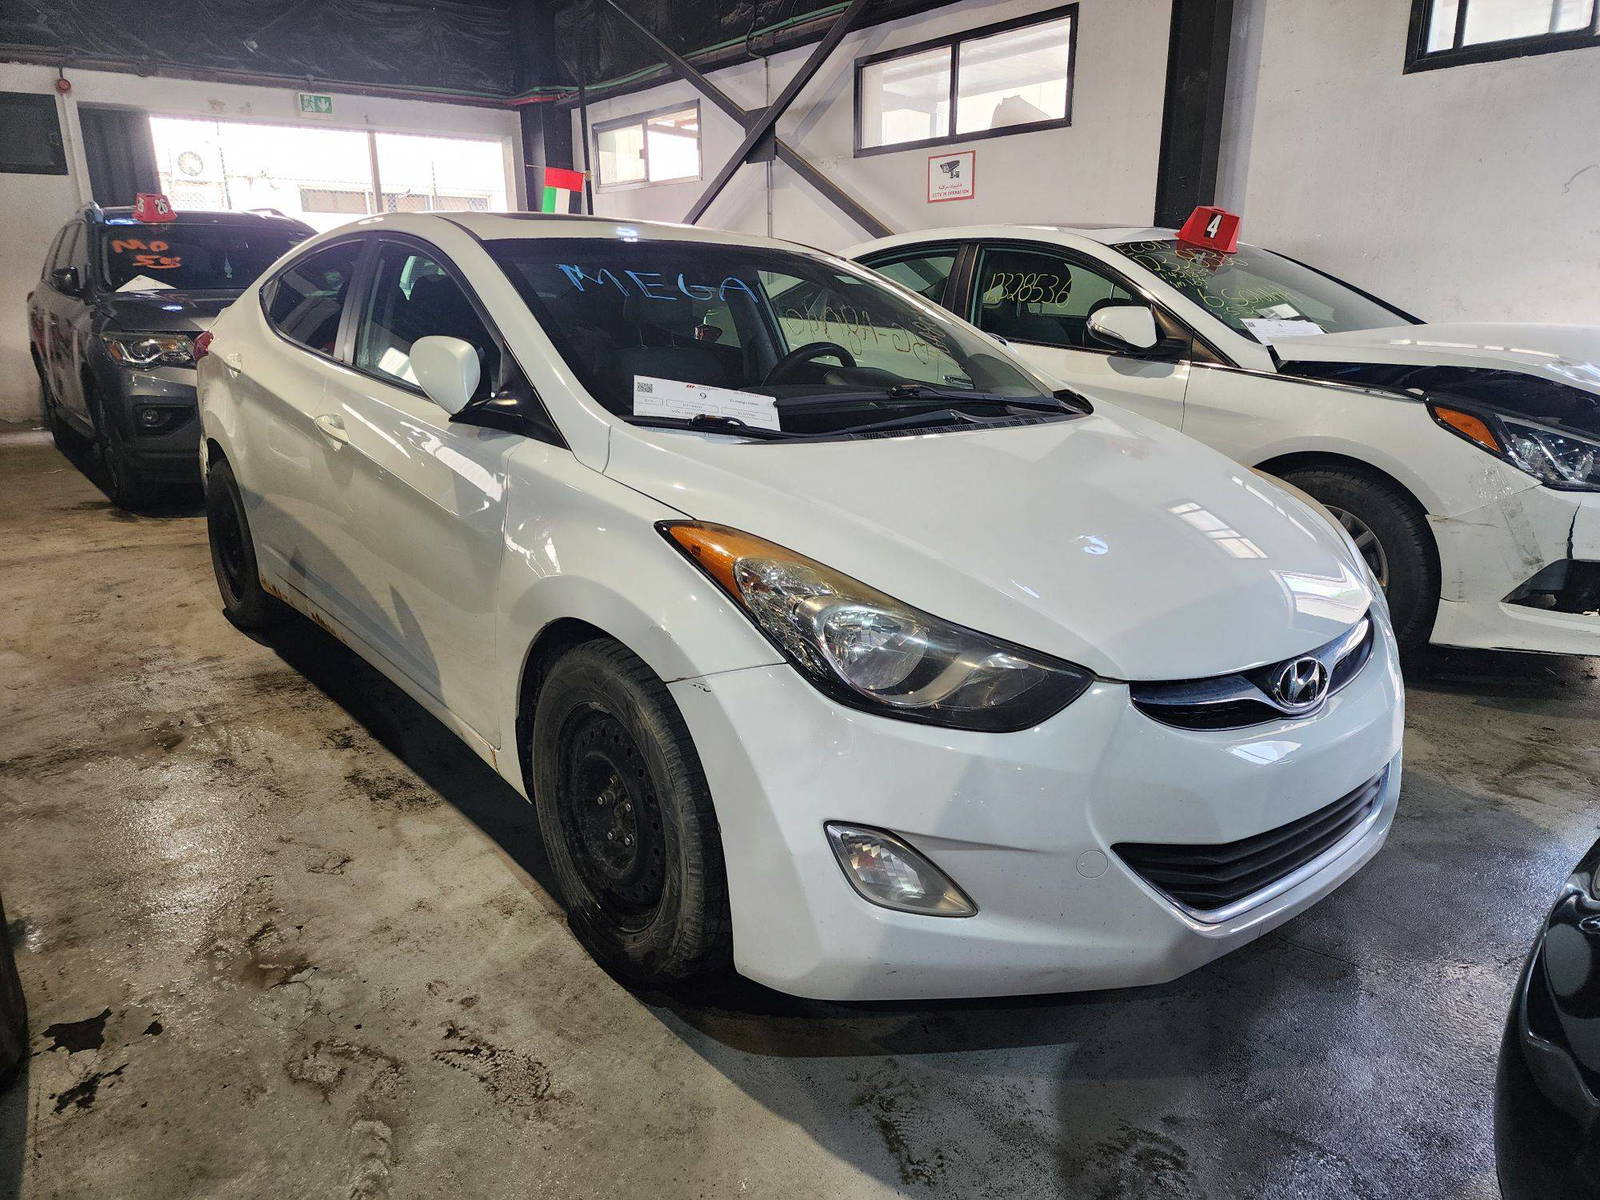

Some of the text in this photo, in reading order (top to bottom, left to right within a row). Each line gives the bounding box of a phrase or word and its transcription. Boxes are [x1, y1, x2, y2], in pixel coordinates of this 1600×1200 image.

[155, 198, 169, 215] 26
[1206, 214, 1223, 239] 4
[556, 263, 759, 304] MEGA
[699, 391, 708, 400] 9
